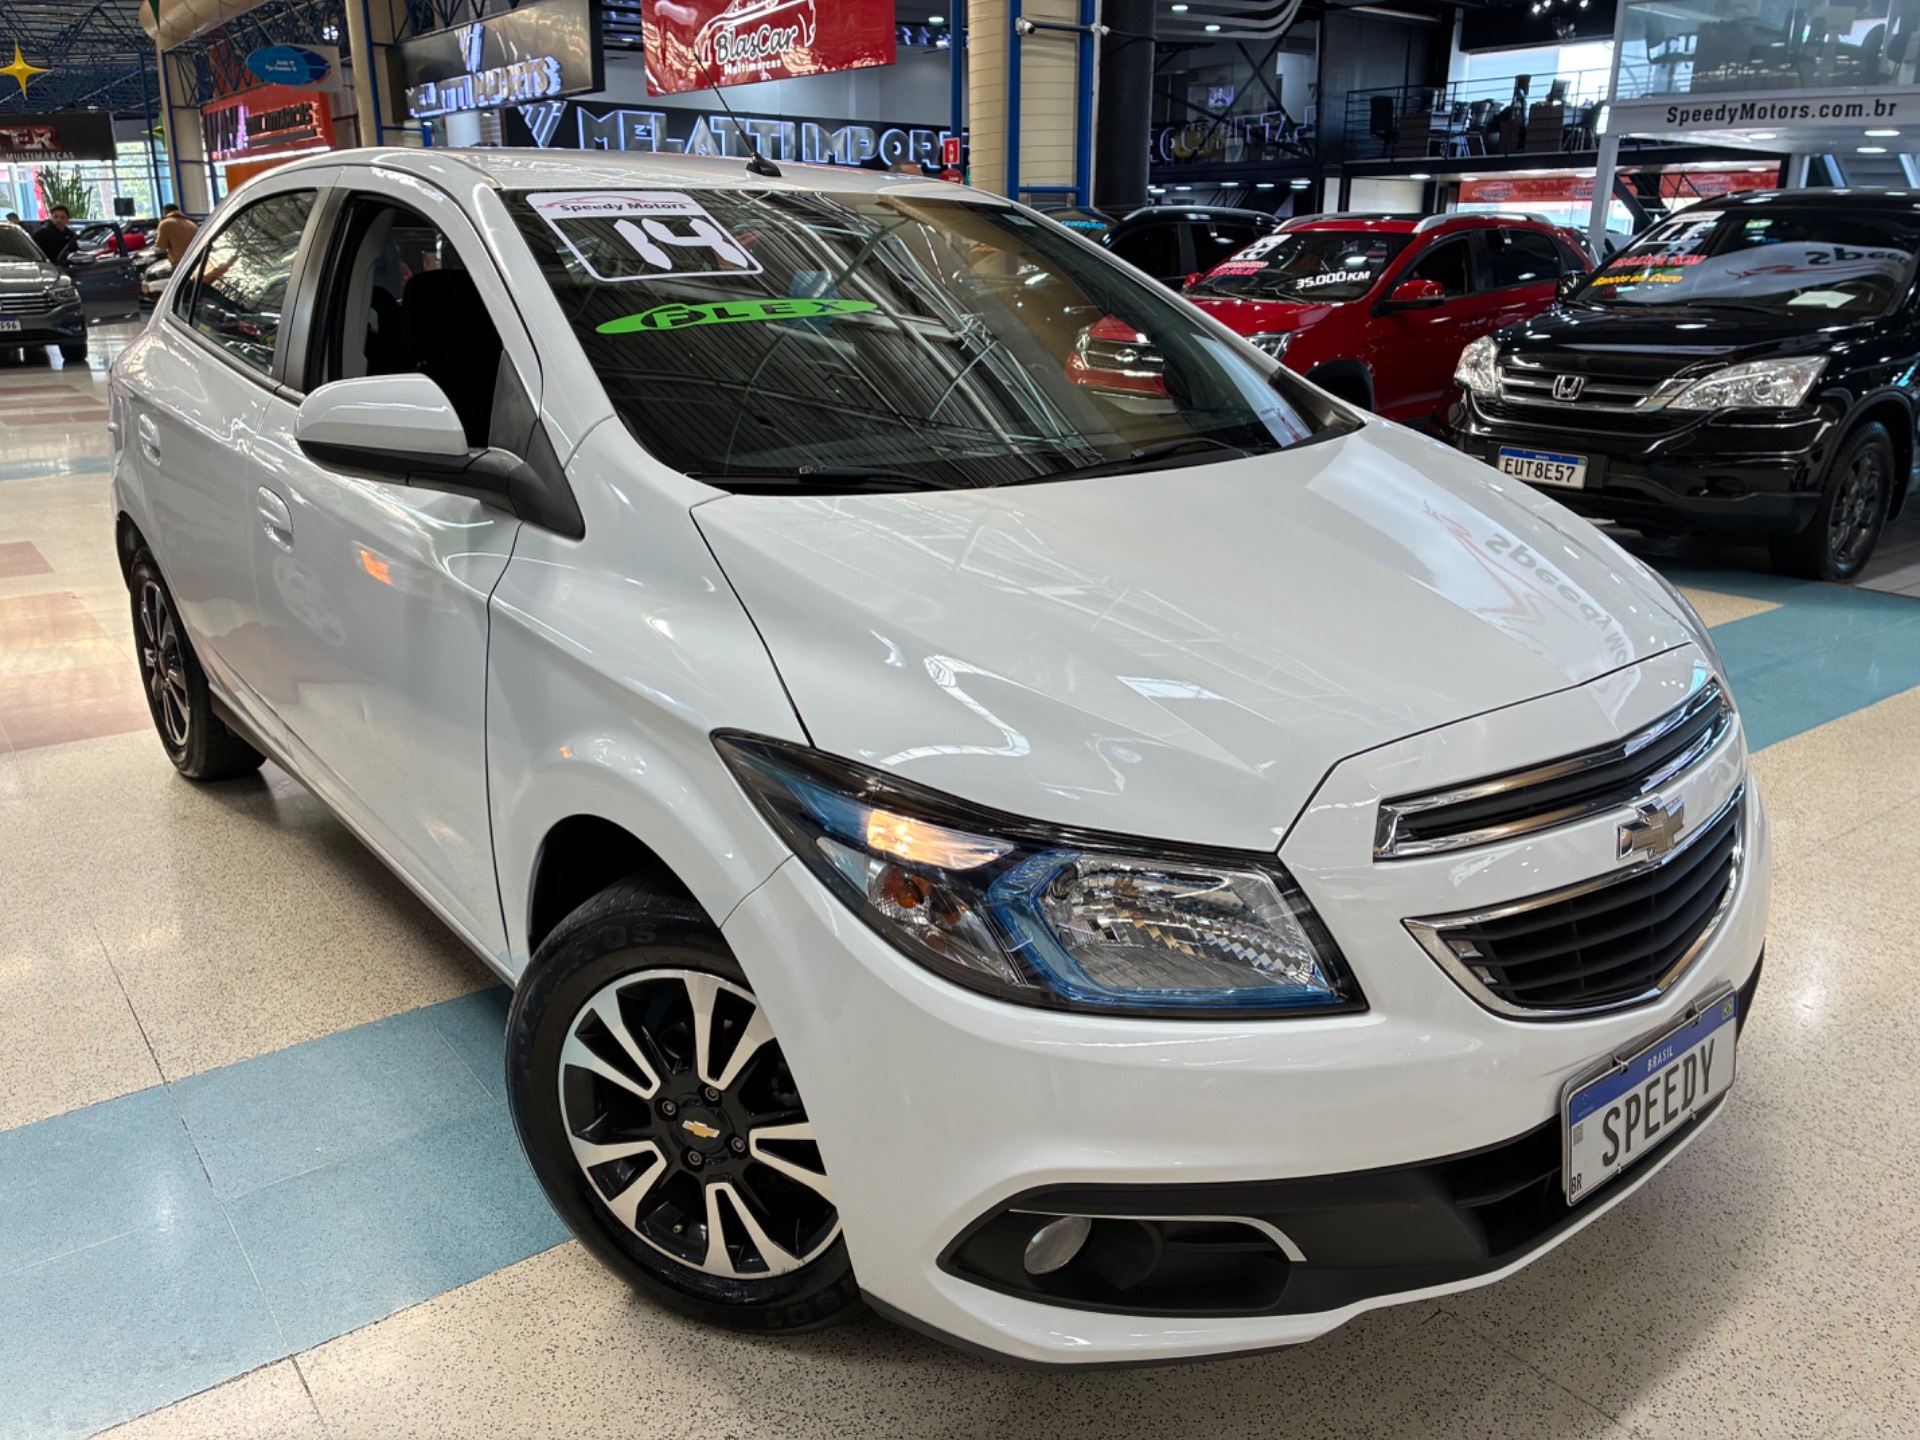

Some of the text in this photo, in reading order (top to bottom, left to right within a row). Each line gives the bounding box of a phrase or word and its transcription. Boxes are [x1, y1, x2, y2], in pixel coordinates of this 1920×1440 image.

[714, 24, 799, 64] BlasCar
[724, 59, 782, 75] Multimarcas
[1666, 99, 1897, 126] SpeedyMotors.com.br
[6, 151, 75, 160] MULTIMARCAS
[560, 201, 688, 213] Speedy Motors
[613, 218, 749, 271] 14
[1295, 270, 1371, 290] 35.000 KM
[651, 300, 846, 329] FLEX
[1503, 457, 1576, 483] EUT8E57
[1647, 1044, 1674, 1071] BRASIL
[1602, 1038, 1716, 1168] SPEEDY
[1571, 1172, 1583, 1195] BR
